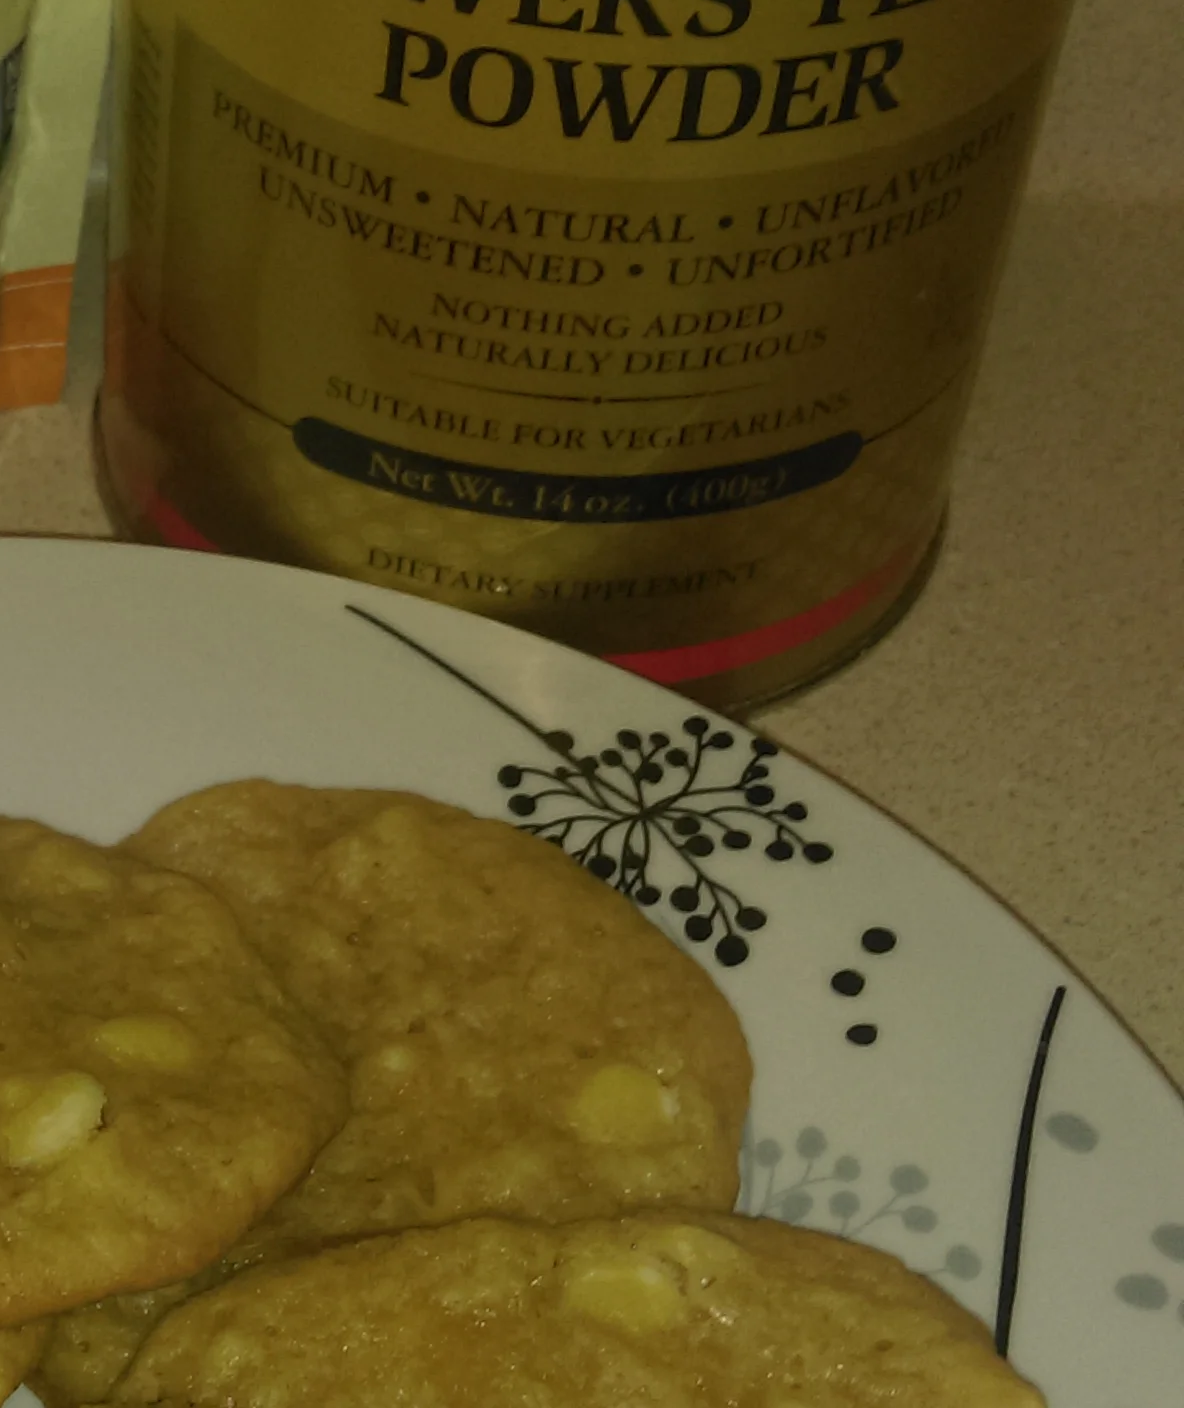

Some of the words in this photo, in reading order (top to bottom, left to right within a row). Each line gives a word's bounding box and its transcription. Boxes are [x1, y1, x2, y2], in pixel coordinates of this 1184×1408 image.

[375, 21, 905, 144] POWDER
[213, 92, 397, 205] PREMIUM
[449, 193, 694, 245] NATURAL
[258, 165, 605, 286] UNSWEETENED
[668, 187, 964, 286] UNFORTIFIED
[372, 312, 613, 376] NATURALLY
[623, 325, 829, 375] DELICIOUS
[430, 292, 631, 341] NOTHING
[643, 300, 784, 340] ADDED
[325, 376, 501, 443] SUITABLE
[512, 421, 587, 451] FOR
[600, 389, 853, 452] VEGETARIANS
[367, 450, 434, 496] Net
[445, 469, 514, 513] Wt.
[532, 482, 575, 516] 14
[584, 493, 647, 517] oz.
[366, 545, 524, 595] DIETARY
